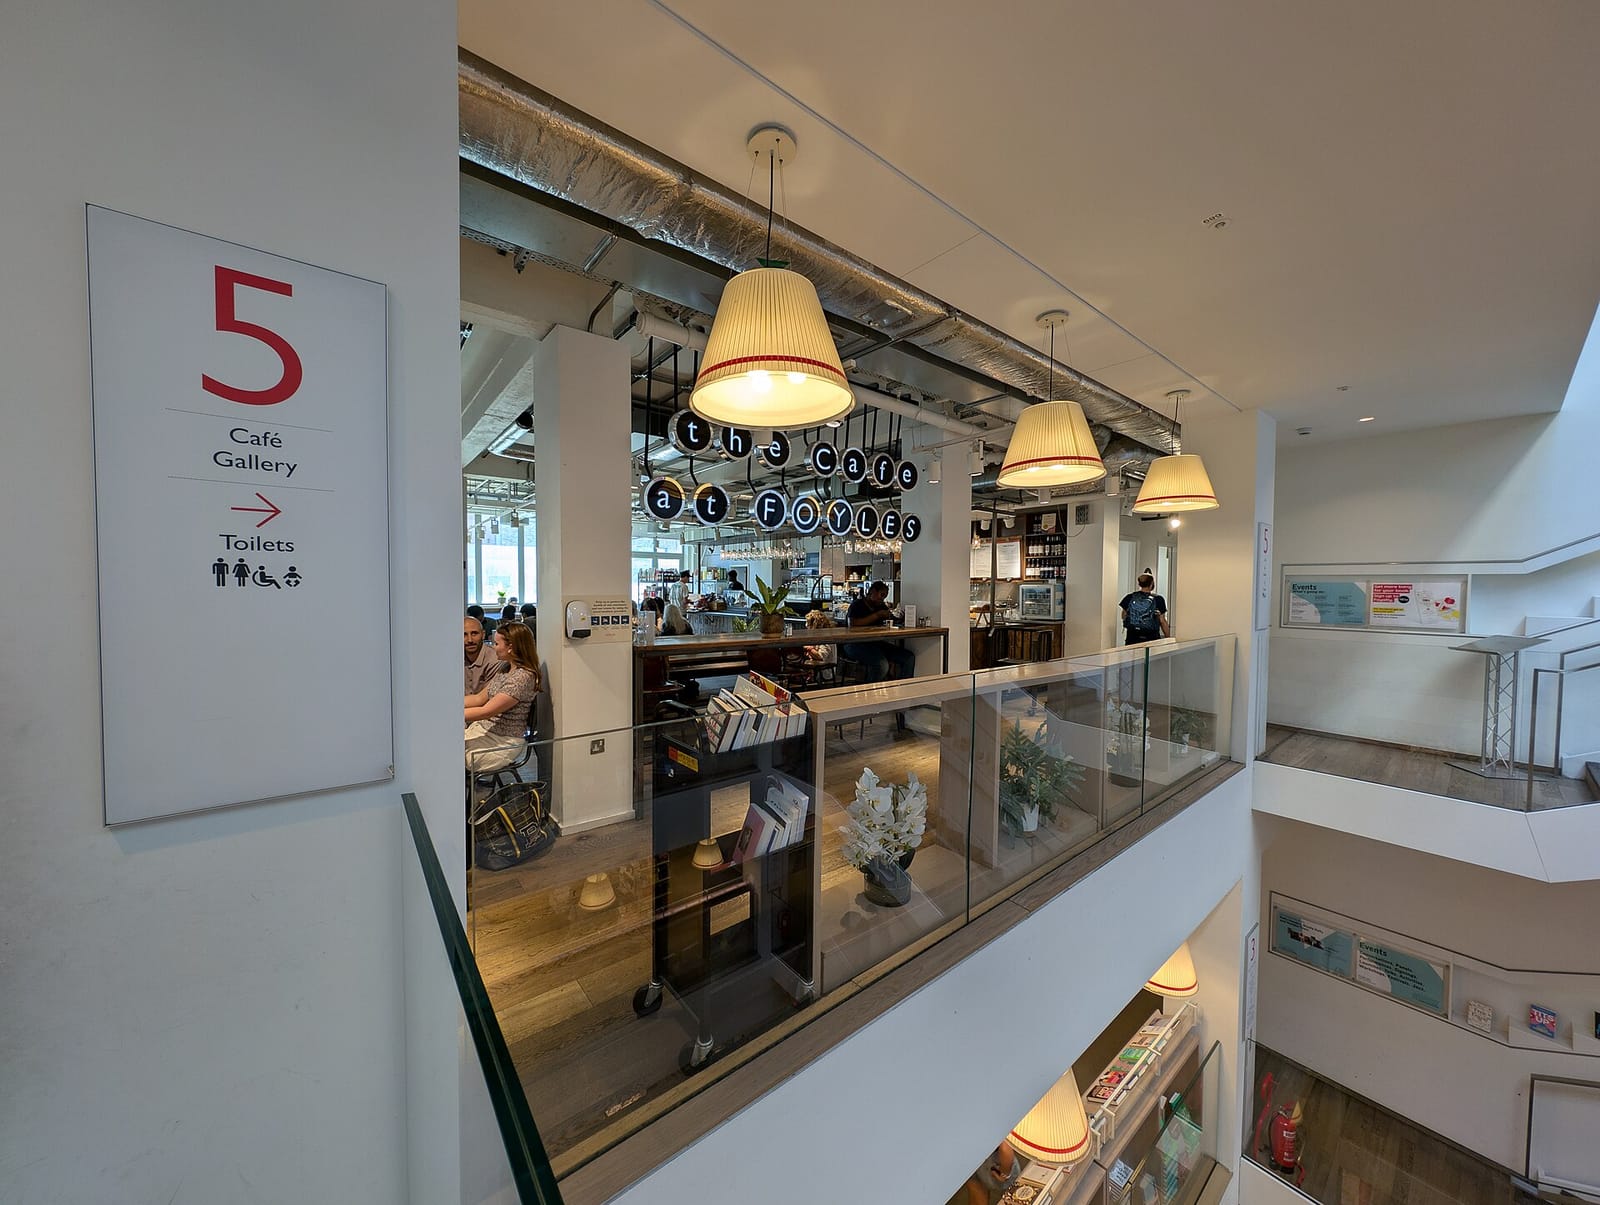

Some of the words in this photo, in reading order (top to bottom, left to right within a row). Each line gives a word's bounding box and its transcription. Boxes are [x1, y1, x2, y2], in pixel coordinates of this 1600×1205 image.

[202, 265, 303, 405] 5
[229, 427, 282, 448] Café
[687, 421, 782, 459] the
[212, 451, 297, 478] Gallery
[656, 490, 717, 515] at
[763, 498, 916, 540] FOYLES
[219, 534, 295, 553] Toilets
[1360, 941, 1388, 957] Events
